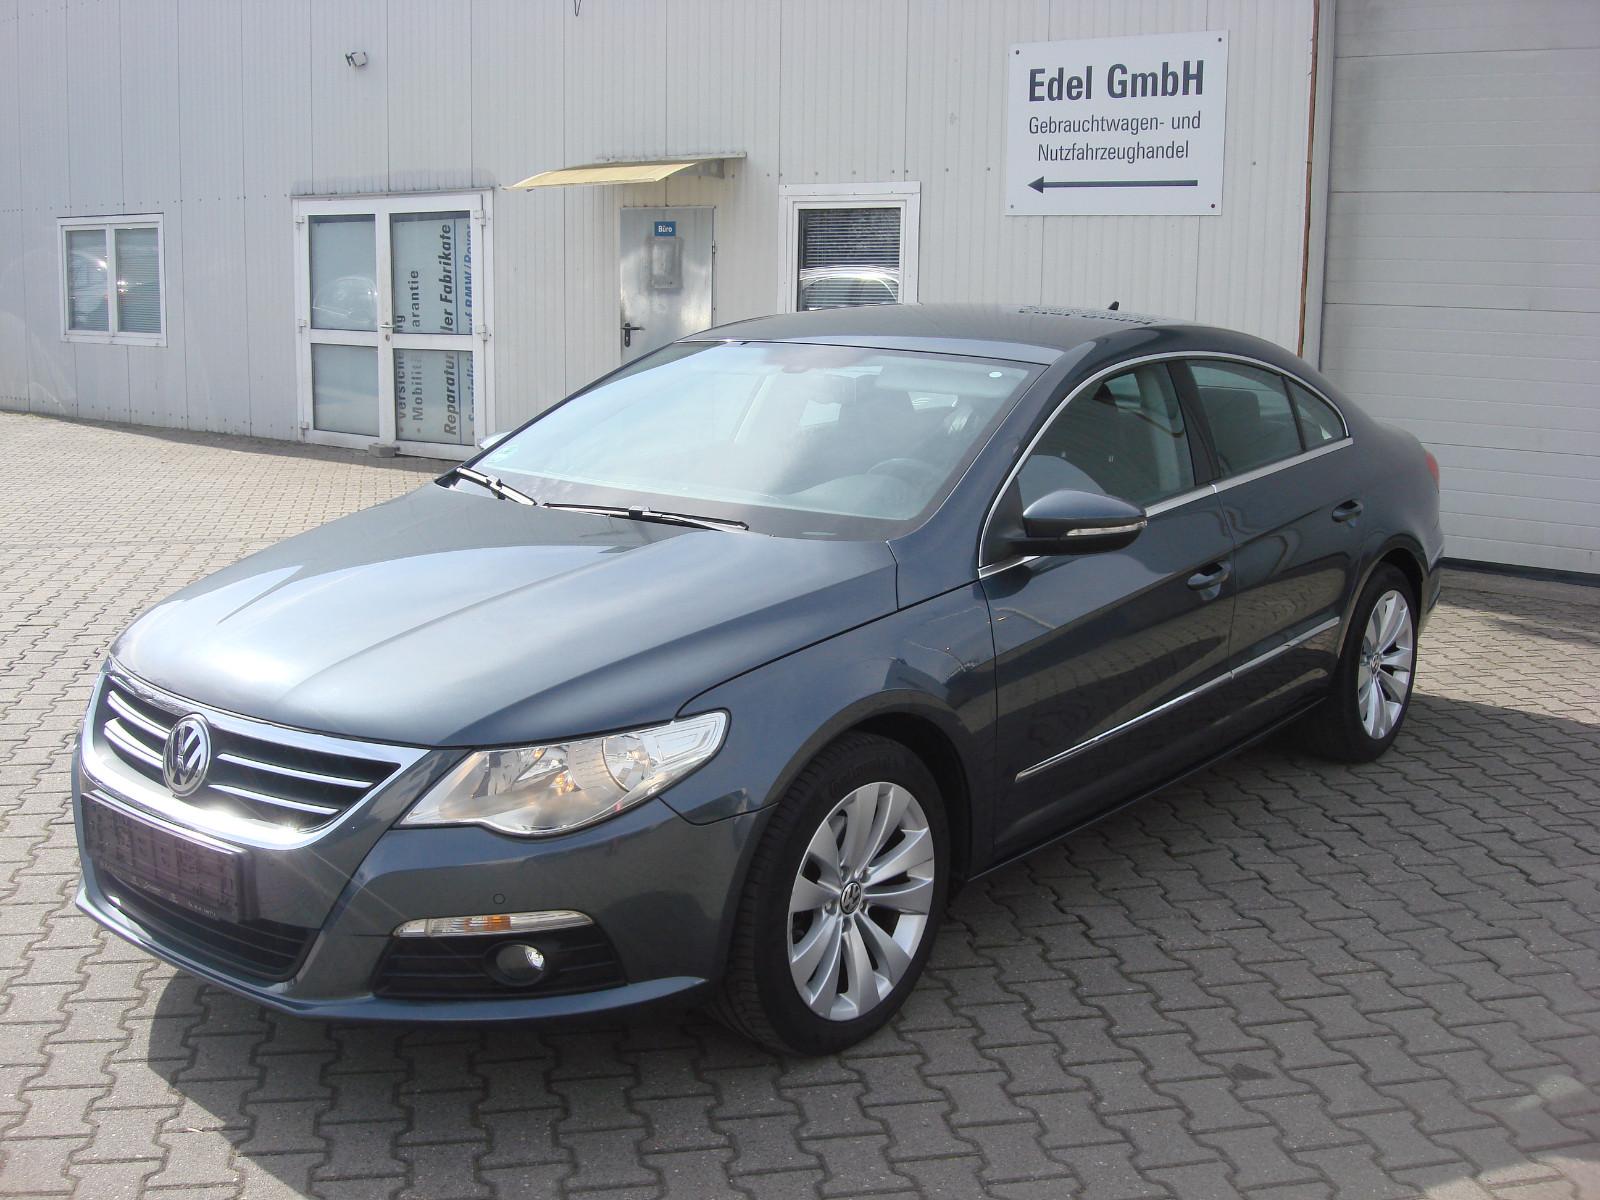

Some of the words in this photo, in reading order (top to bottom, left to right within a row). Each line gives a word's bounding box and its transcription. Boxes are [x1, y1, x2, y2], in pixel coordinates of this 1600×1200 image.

[1028, 66, 1093, 102] Edel
[1106, 59, 1204, 99] GmbH
[1028, 114, 1165, 136] Gebrauchtwagen-
[1171, 110, 1201, 130] und
[1037, 140, 1189, 164] Nutzfahrzeughandel
[438, 224, 453, 303] Fabrikate
[407, 270, 421, 327] arantie
[440, 308, 454, 333] ler
